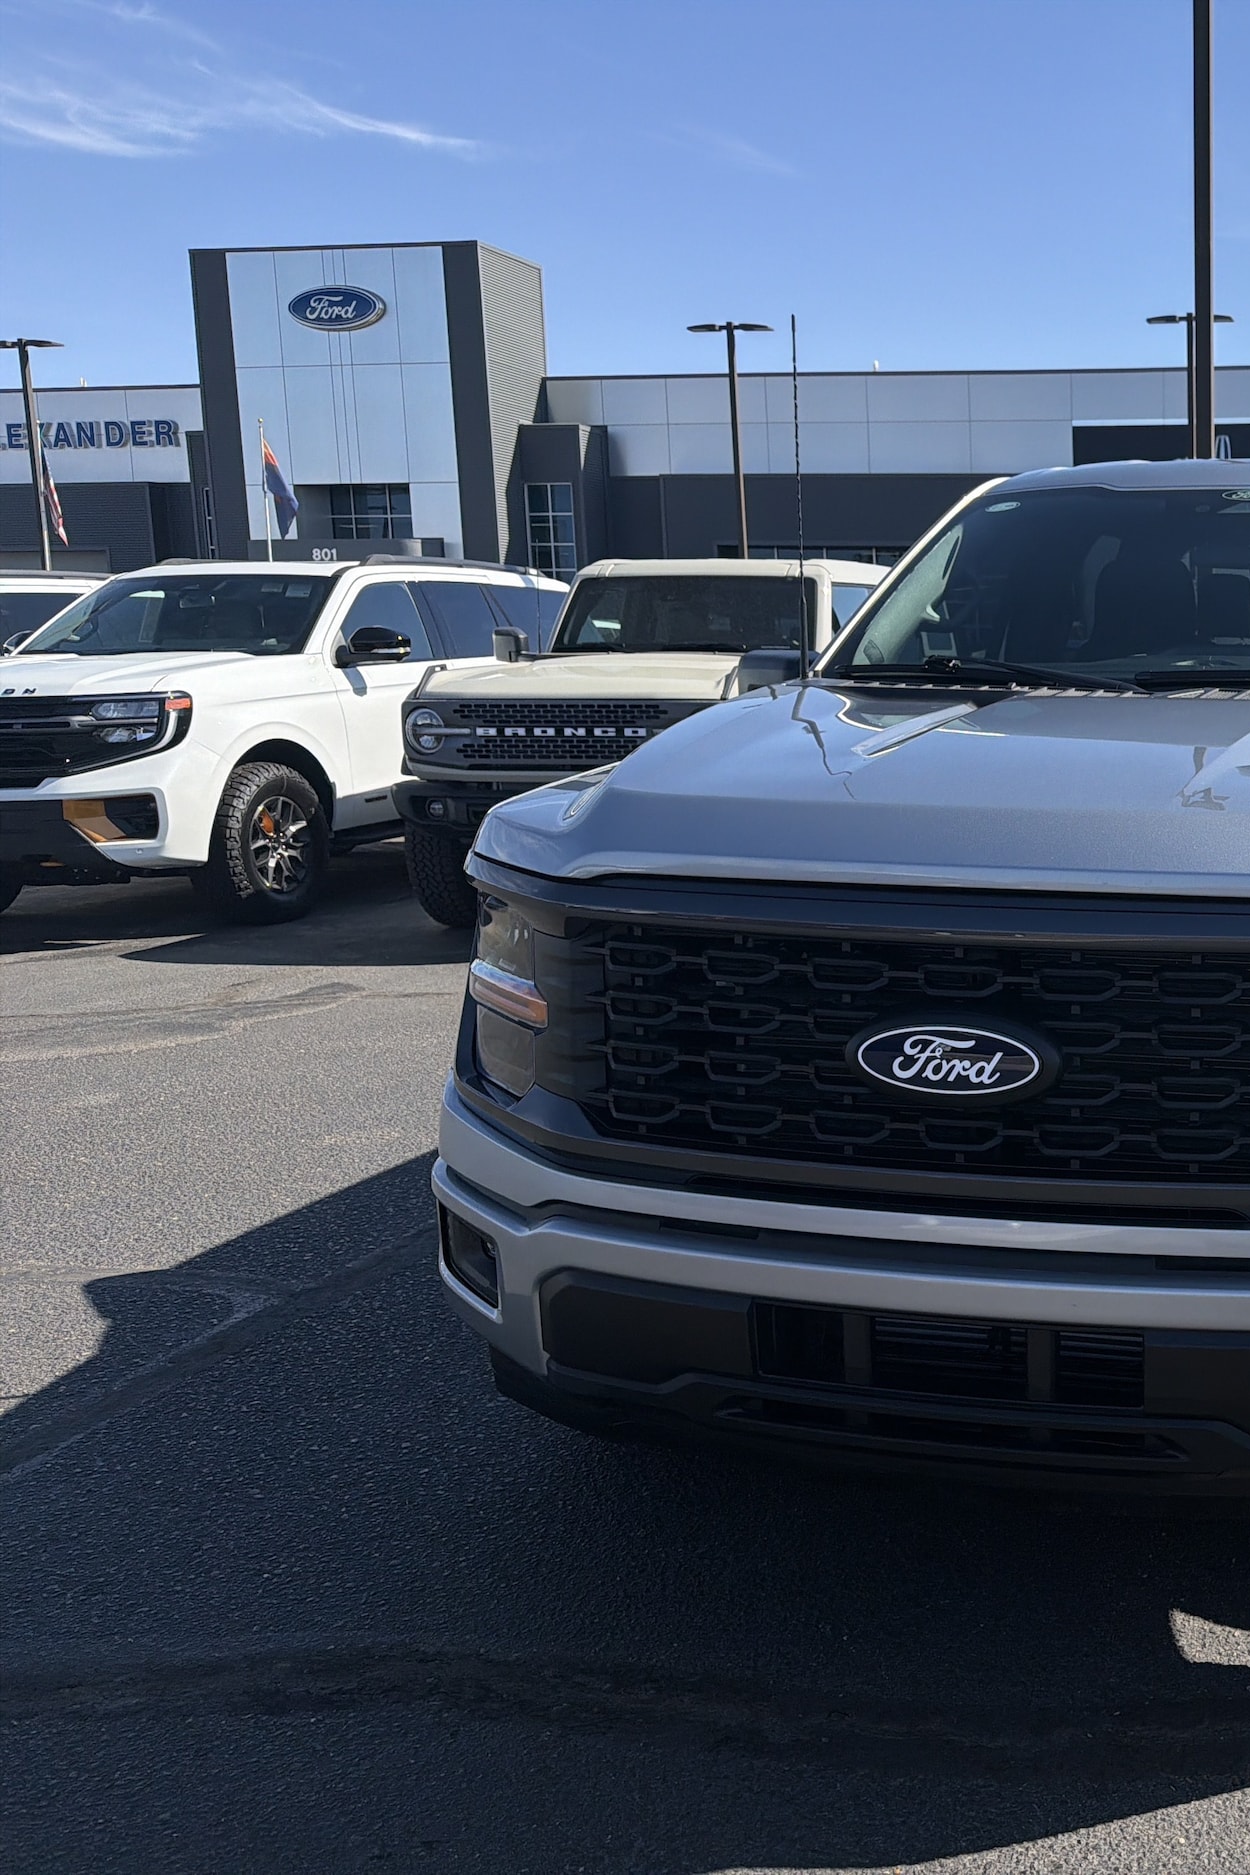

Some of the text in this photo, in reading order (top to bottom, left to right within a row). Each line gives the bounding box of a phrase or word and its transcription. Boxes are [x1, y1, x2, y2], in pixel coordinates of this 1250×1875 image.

[306, 295, 357, 320] Ford
[312, 547, 338, 561] 801
[475, 727, 647, 737] BRONCO
[892, 1035, 1003, 1084] Ford
